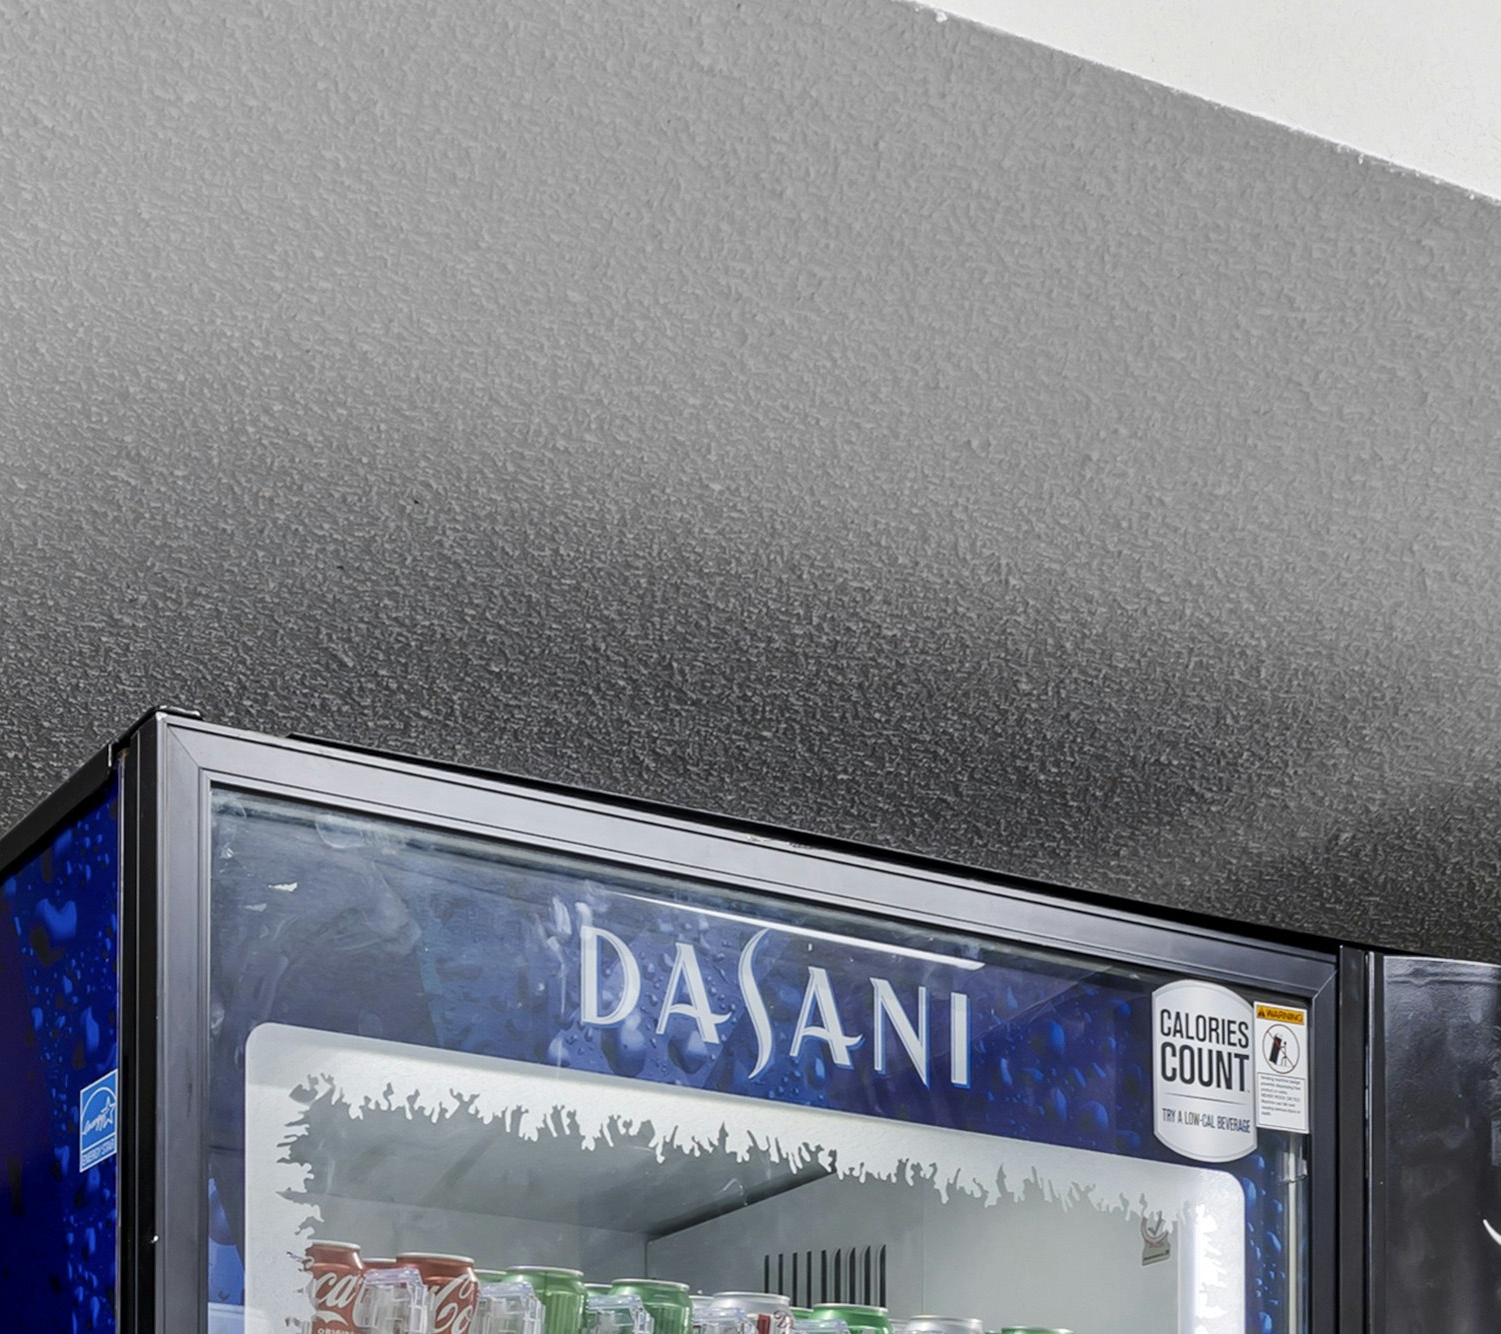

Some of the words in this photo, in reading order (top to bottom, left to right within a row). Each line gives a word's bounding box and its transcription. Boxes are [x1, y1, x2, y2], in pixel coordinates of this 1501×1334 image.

[580, 923, 972, 1090] DASANI
[1266, 1009, 1304, 1023] WARNING
[1160, 1009, 1249, 1049] CALORIES
[1161, 1041, 1250, 1093] COUNT
[1162, 1108, 1176, 1123] TRY
[1177, 1110, 1183, 1123] A
[1184, 1111, 1216, 1129] LOW-CAL
[1217, 1115, 1251, 1133] BEVERAGE
